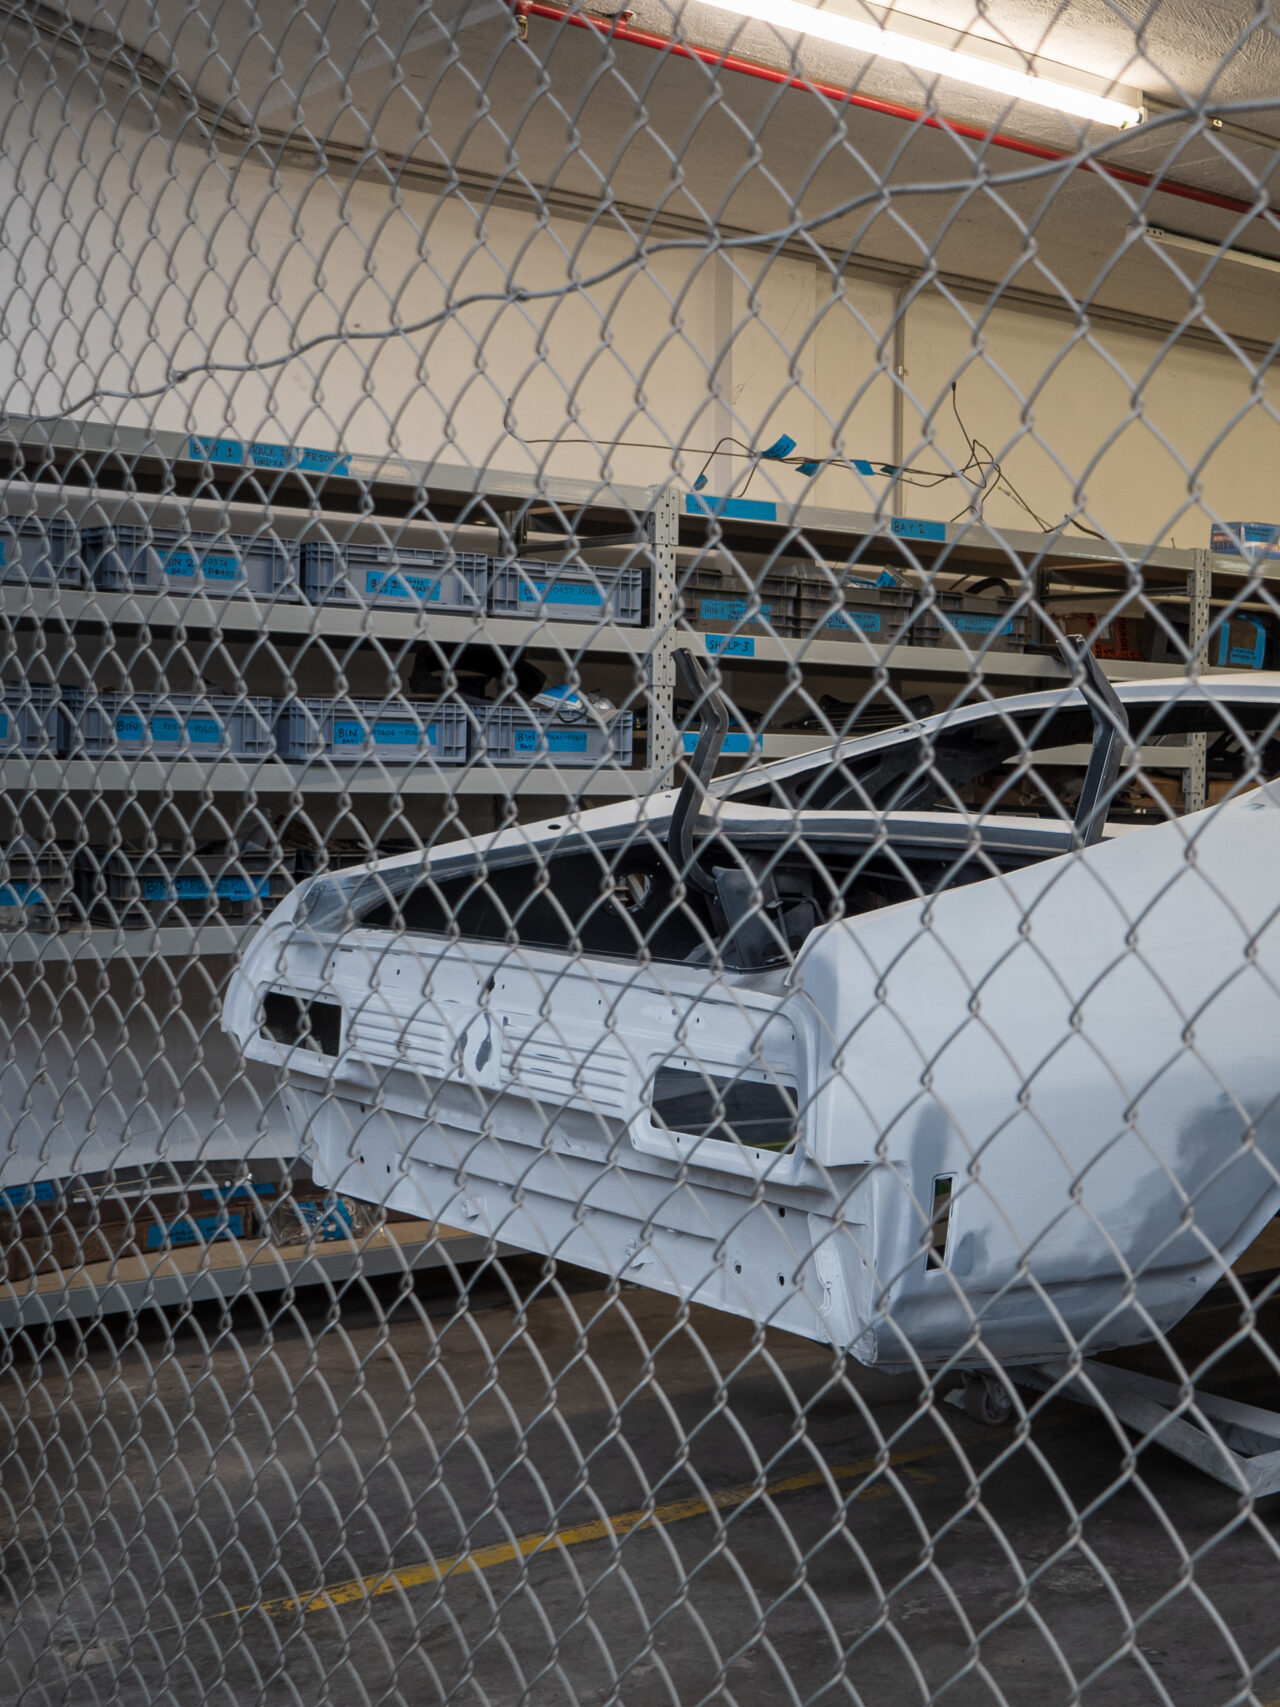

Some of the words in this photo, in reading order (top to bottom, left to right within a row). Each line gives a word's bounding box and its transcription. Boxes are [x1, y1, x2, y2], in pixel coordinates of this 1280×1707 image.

[894, 520, 915, 533] BAY
[918, 523, 926, 534] 2
[117, 720, 138, 732] BIN
[338, 727, 357, 738] BIN
[518, 732, 535, 741] BIN
